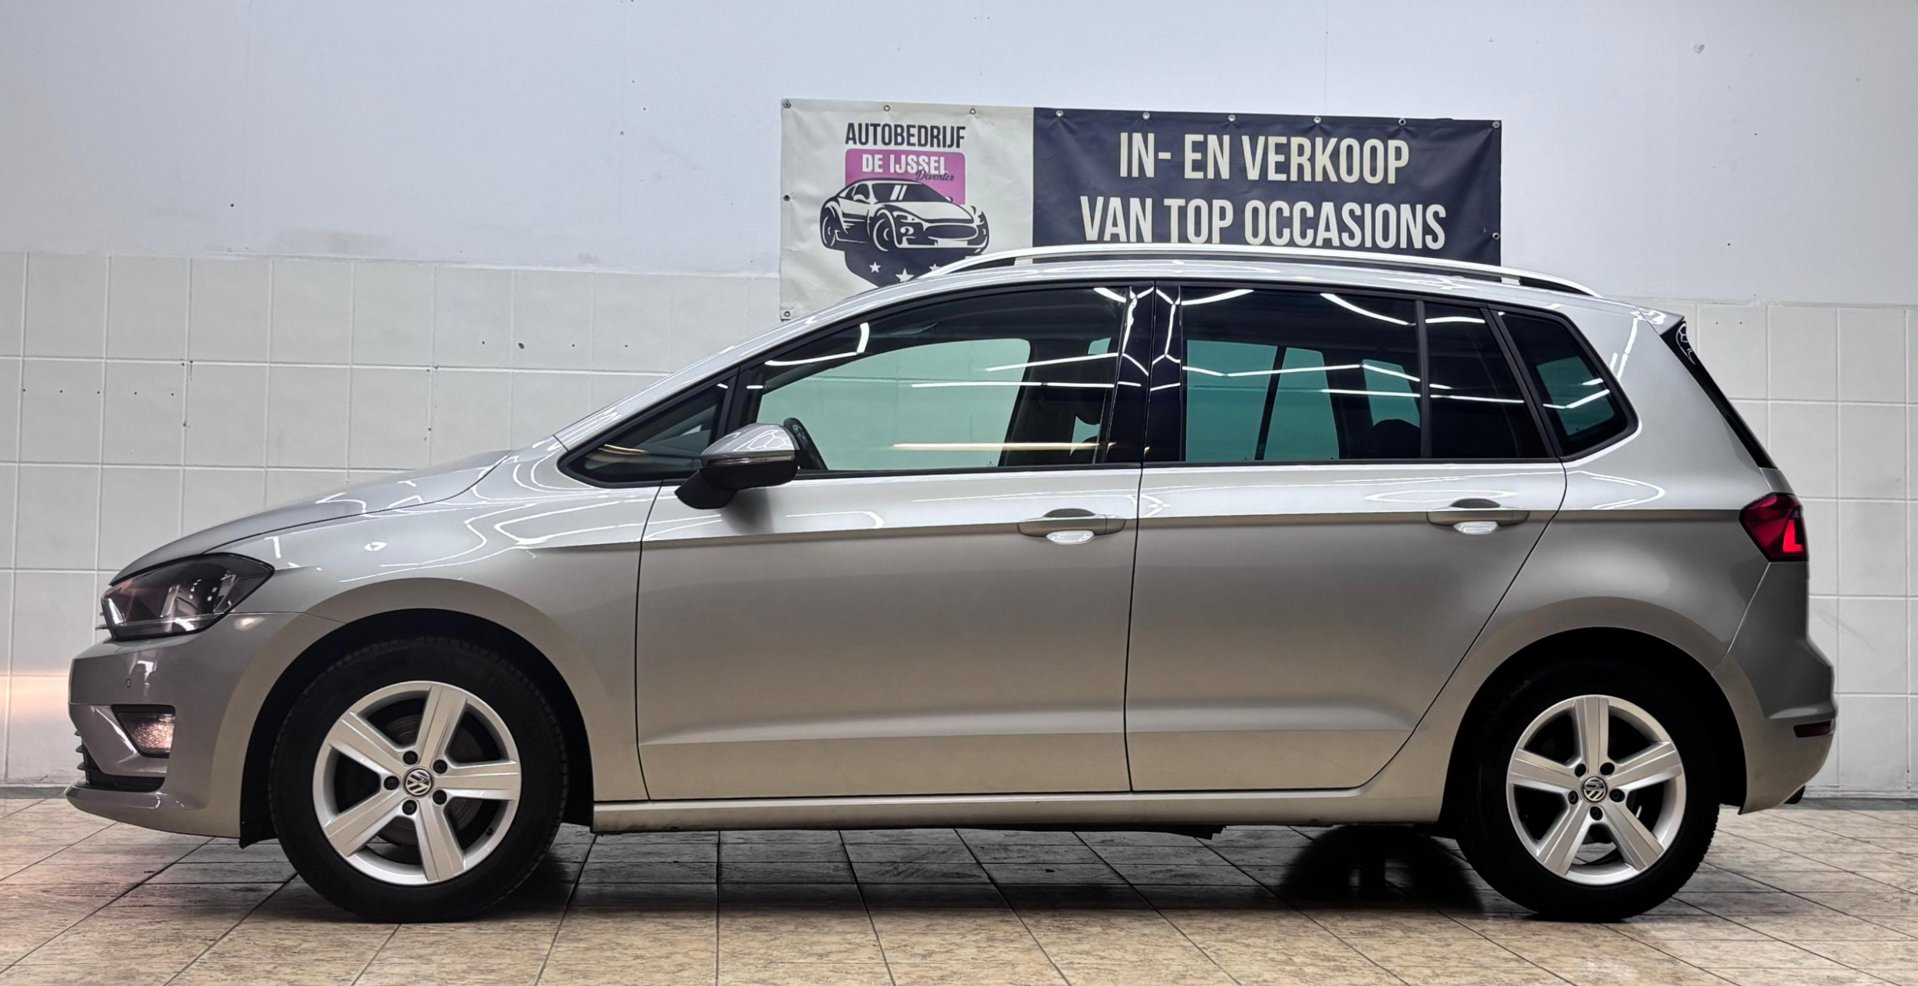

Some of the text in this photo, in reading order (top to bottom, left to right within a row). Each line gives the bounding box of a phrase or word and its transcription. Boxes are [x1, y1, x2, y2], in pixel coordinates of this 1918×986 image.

[845, 122, 966, 149] AUTOBEDRIJF
[862, 153, 948, 175] DE IJSSEL
[1119, 132, 1410, 184] IN- EN VERKOOP
[915, 169, 955, 182] Deventer
[1080, 195, 1447, 250] VAN TOP OCCASIONS
